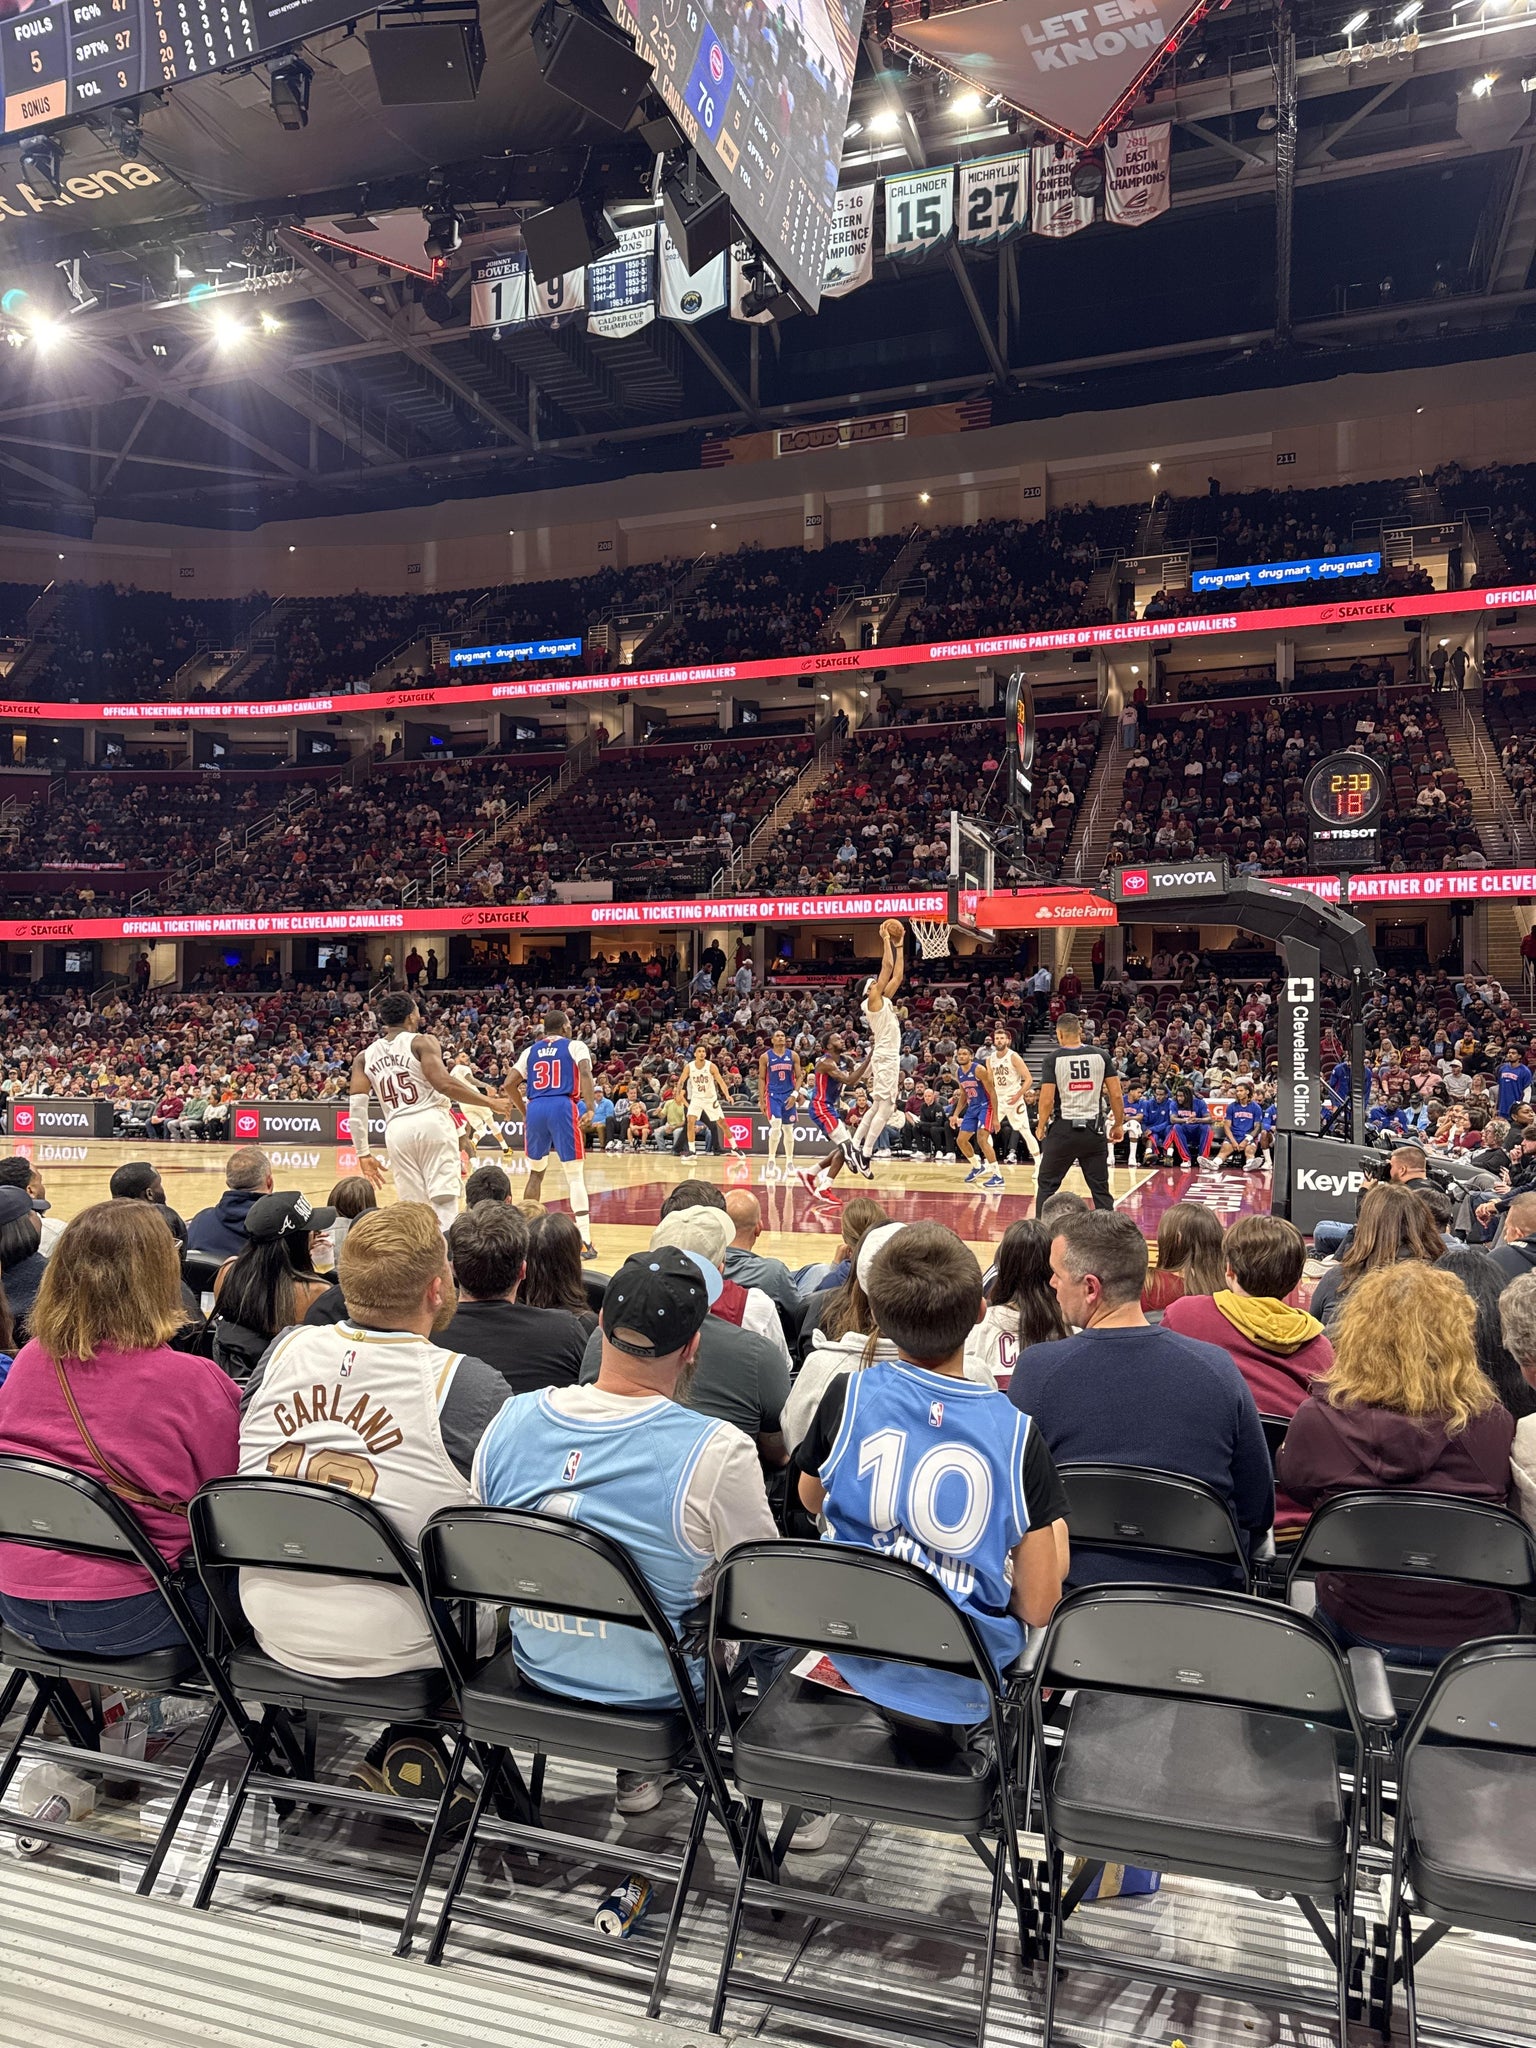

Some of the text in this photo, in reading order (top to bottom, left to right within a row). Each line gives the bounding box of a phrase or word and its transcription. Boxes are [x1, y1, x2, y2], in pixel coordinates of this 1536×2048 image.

[74, 3, 101, 24] FG%
[687, 3, 697, 32] 18
[1020, 0, 1158, 45] LET EM
[14, 17, 53, 42] FOULS
[75, 30, 131, 61] 3PT% 37
[649, 14, 677, 72] 2:33
[1031, 18, 1167, 72] KNOW
[30, 50, 42, 73] 5
[160, 46, 174, 63] 20
[163, 64, 177, 80] 31
[616, 1, 699, 143] CLEVELAND CAVALIERS
[76, 71, 127, 98] TOL 3
[697, 81, 715, 128] 76
[736, 83, 750, 108] FOULS
[21, 96, 51, 119] BONUS
[733, 110, 740, 130] 5
[754, 115, 780, 159] FG% 47
[1126, 136, 1148, 149] 2011
[747, 140, 774, 183] 3PT% 37
[1052, 150, 1075, 163] 214
[1125, 149, 1148, 164] EAST
[968, 164, 1020, 184] MICHAYLUK
[1041, 161, 1074, 178] AMERIC
[1116, 160, 1159, 178] DIVISION
[740, 165, 765, 207] TOL 3
[891, 178, 947, 198] CALLANDER
[1035, 178, 1072, 191] CONFER
[1109, 171, 1166, 191] CHAMPIONS
[832, 195, 863, 214] 5-16
[968, 181, 1019, 231] 27
[1037, 190, 1078, 204] CHAMPIO
[831, 213, 862, 230] STERN
[897, 195, 941, 244] 15
[828, 227, 870, 245] FERENCE
[825, 242, 866, 260] AMPIONS
[477, 262, 520, 279] BOWER
[486, 258, 512, 268] JOHNNY
[491, 282, 502, 320] 1
[547, 277, 564, 309] 9
[609, 297, 633, 308] 1963-64
[598, 311, 644, 325] CALDER CUP
[598, 319, 643, 332] CHAMPIONS
[1277, 454, 1295, 464] 211
[1024, 487, 1041, 497] 210
[806, 516, 821, 526] 209
[407, 564, 420, 573] 207
[1199, 558, 1373, 586] drug mart drug mart drug mart
[1338, 602, 1396, 618] SEATGEEK
[930, 617, 1237, 658] OFFICIAL TICKETING PARTNER OF THE CLEVELAND CAVALIERS
[454, 642, 577, 663] drug mart drug mart drug mart
[815, 656, 860, 668] SEATGEEK
[492, 667, 736, 697] OFFICIAL TICKETING PARTNER OF THE CLEVELAND CAVALIERS
[103, 700, 332, 716] OFFICIAL TICKETING PARTNER OF THE CLEVELAND CAVALIERS
[398, 692, 435, 704] SEATGEEK
[699, 743, 712, 751] 107
[1331, 773, 1371, 792] 2:33
[1338, 793, 1362, 816] 18
[1331, 828, 1377, 839] TISSOT
[1153, 870, 1217, 887] TOYOTA
[1347, 878, 1420, 896] PARTNER
[1423, 877, 1444, 894] OF
[1447, 876, 1477, 893] THE
[478, 897, 943, 924] SEATGEEK OFFICIAL TICKETING PARTNER OF THE CLEVELAND CAVALIERS
[31, 914, 403, 936] SEATGEEK OFFICIAL TICKETING PARTNER OF THE CLEVELAND CAVALIERS
[537, 1047, 559, 1057] GREEN
[369, 1054, 411, 1076] MITCHELL
[533, 1059, 561, 1090] 31
[1069, 1060, 1090, 1080] 56
[1293, 1006, 1310, 1127] Cleveland Clinic
[778, 1070, 786, 1081] 9
[997, 1077, 1007, 1086] 32
[379, 1071, 418, 1109] 45
[697, 1082, 706, 1093] 24
[38, 1113, 89, 1128] TOYOTA
[1213, 1105, 1223, 1116] G
[263, 1117, 321, 1133] TOYOTA
[757, 1126, 829, 1142] TOOTA
[1296, 1168, 1365, 1196] KeyB
[273, 1384, 403, 1455] GARLAND
[857, 1426, 994, 1558] 10
